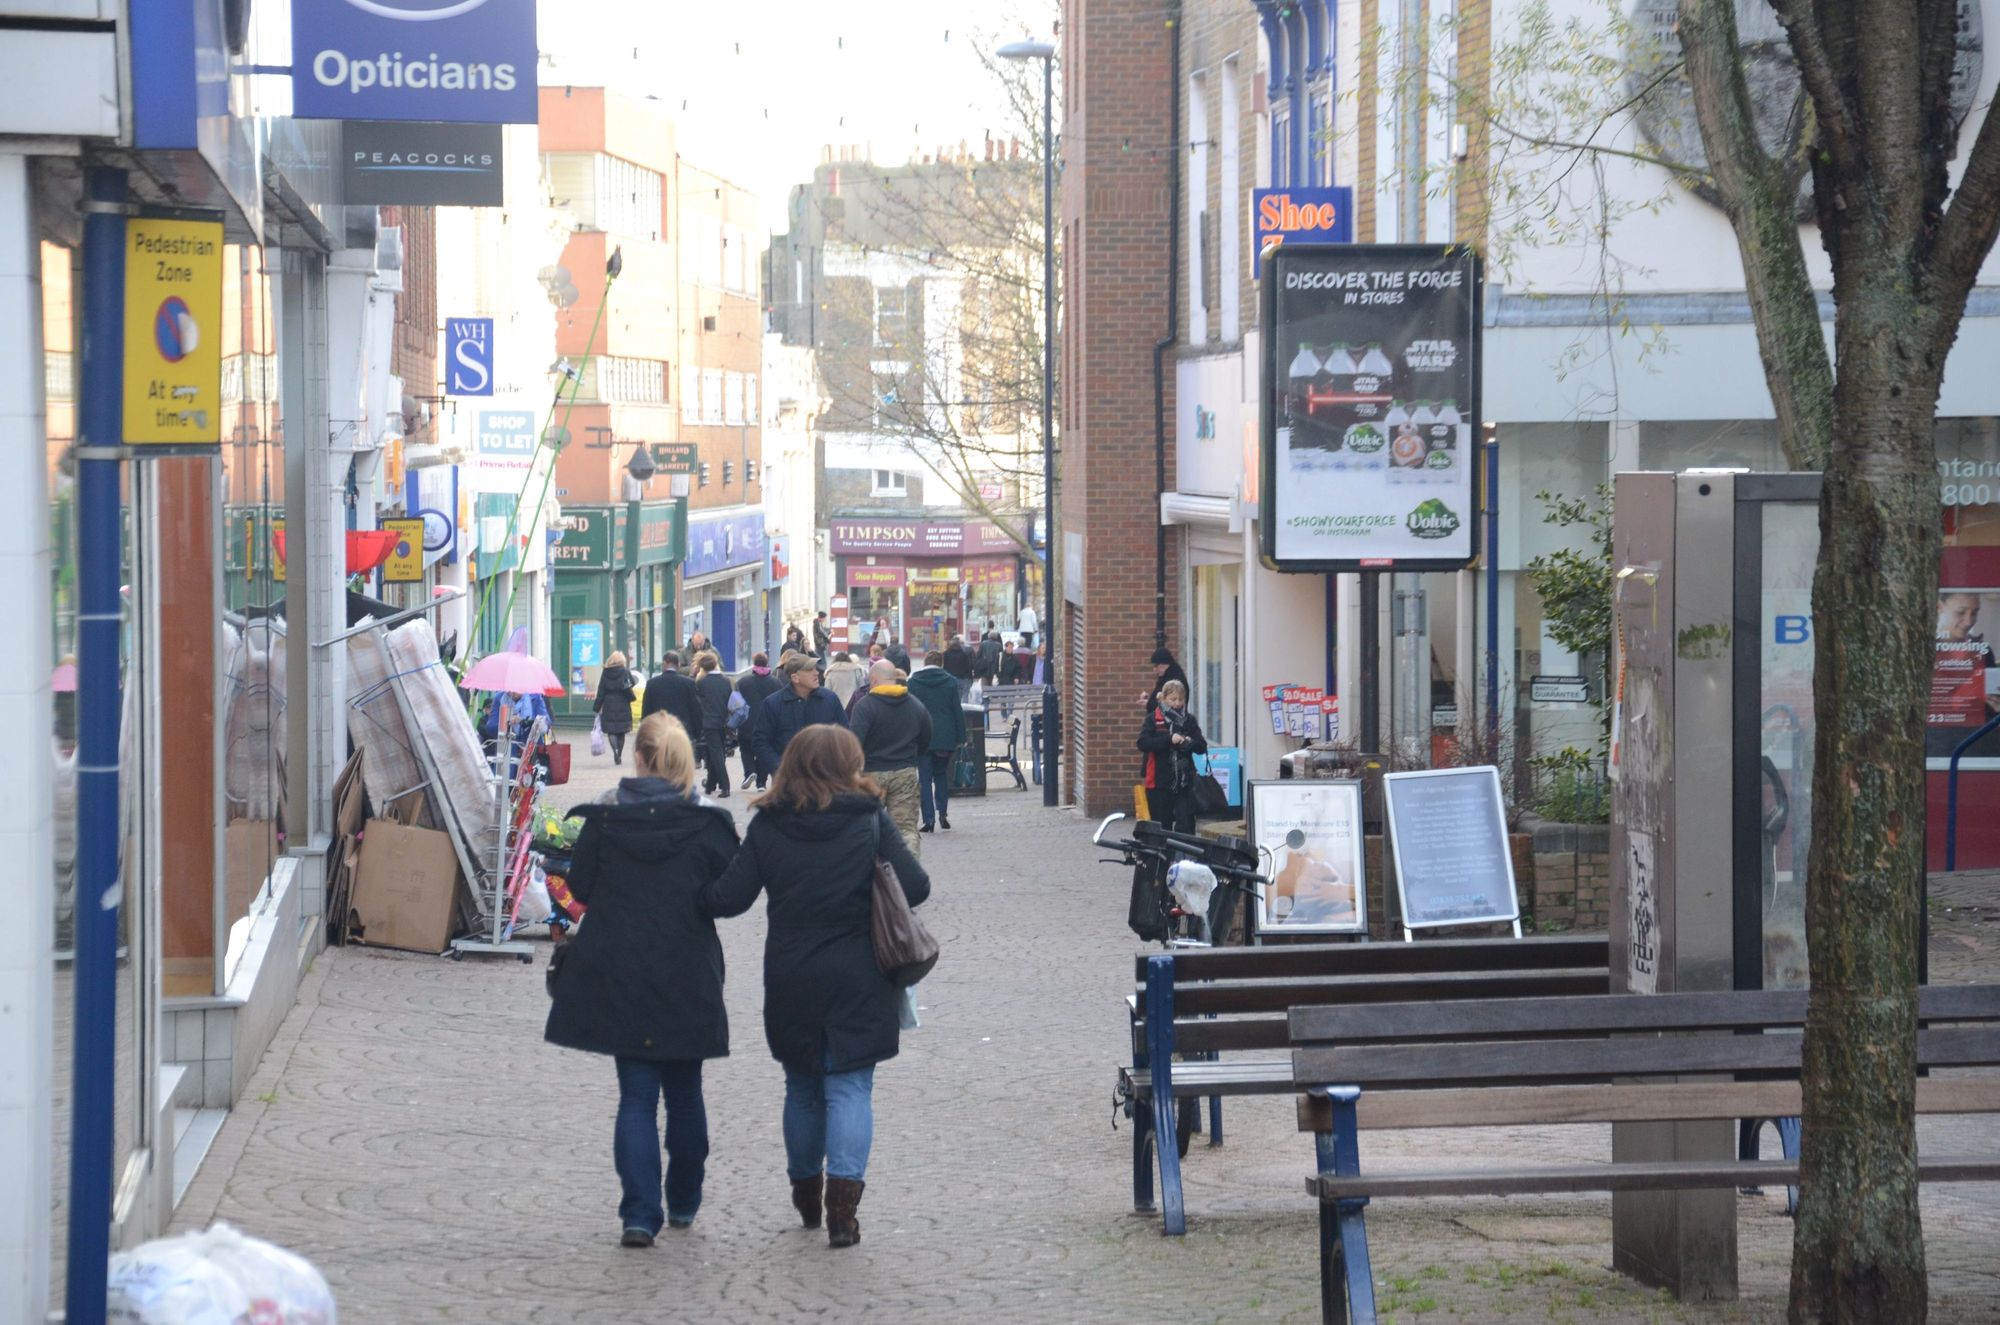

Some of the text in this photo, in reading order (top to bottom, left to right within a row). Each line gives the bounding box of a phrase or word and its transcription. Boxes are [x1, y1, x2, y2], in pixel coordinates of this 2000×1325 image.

[312, 50, 517, 94] Opticians
[354, 152, 493, 165] PEACOCKS
[1259, 194, 1336, 231] Shoe
[136, 233, 214, 255] Pedestrian
[156, 261, 192, 282] Zone
[1286, 270, 1462, 290] DISCOVER THE FORCE
[1344, 291, 1405, 305] IN STORES
[454, 323, 485, 338] WH
[1406, 340, 1456, 353] STAR
[455, 339, 488, 391] S
[1406, 354, 1456, 368] WARS
[148, 380, 164, 399] At
[488, 416, 527, 429] SHOP
[481, 433, 534, 449] TO LET
[1408, 512, 1456, 529] Volvic
[836, 526, 916, 541] TIMPSON
[1313, 528, 1325, 536] ON
[554, 546, 591, 561] RETT
[1774, 615, 1813, 644] B
[1935, 640, 1990, 655] rowsing
[1300, 691, 1322, 702] SALE
